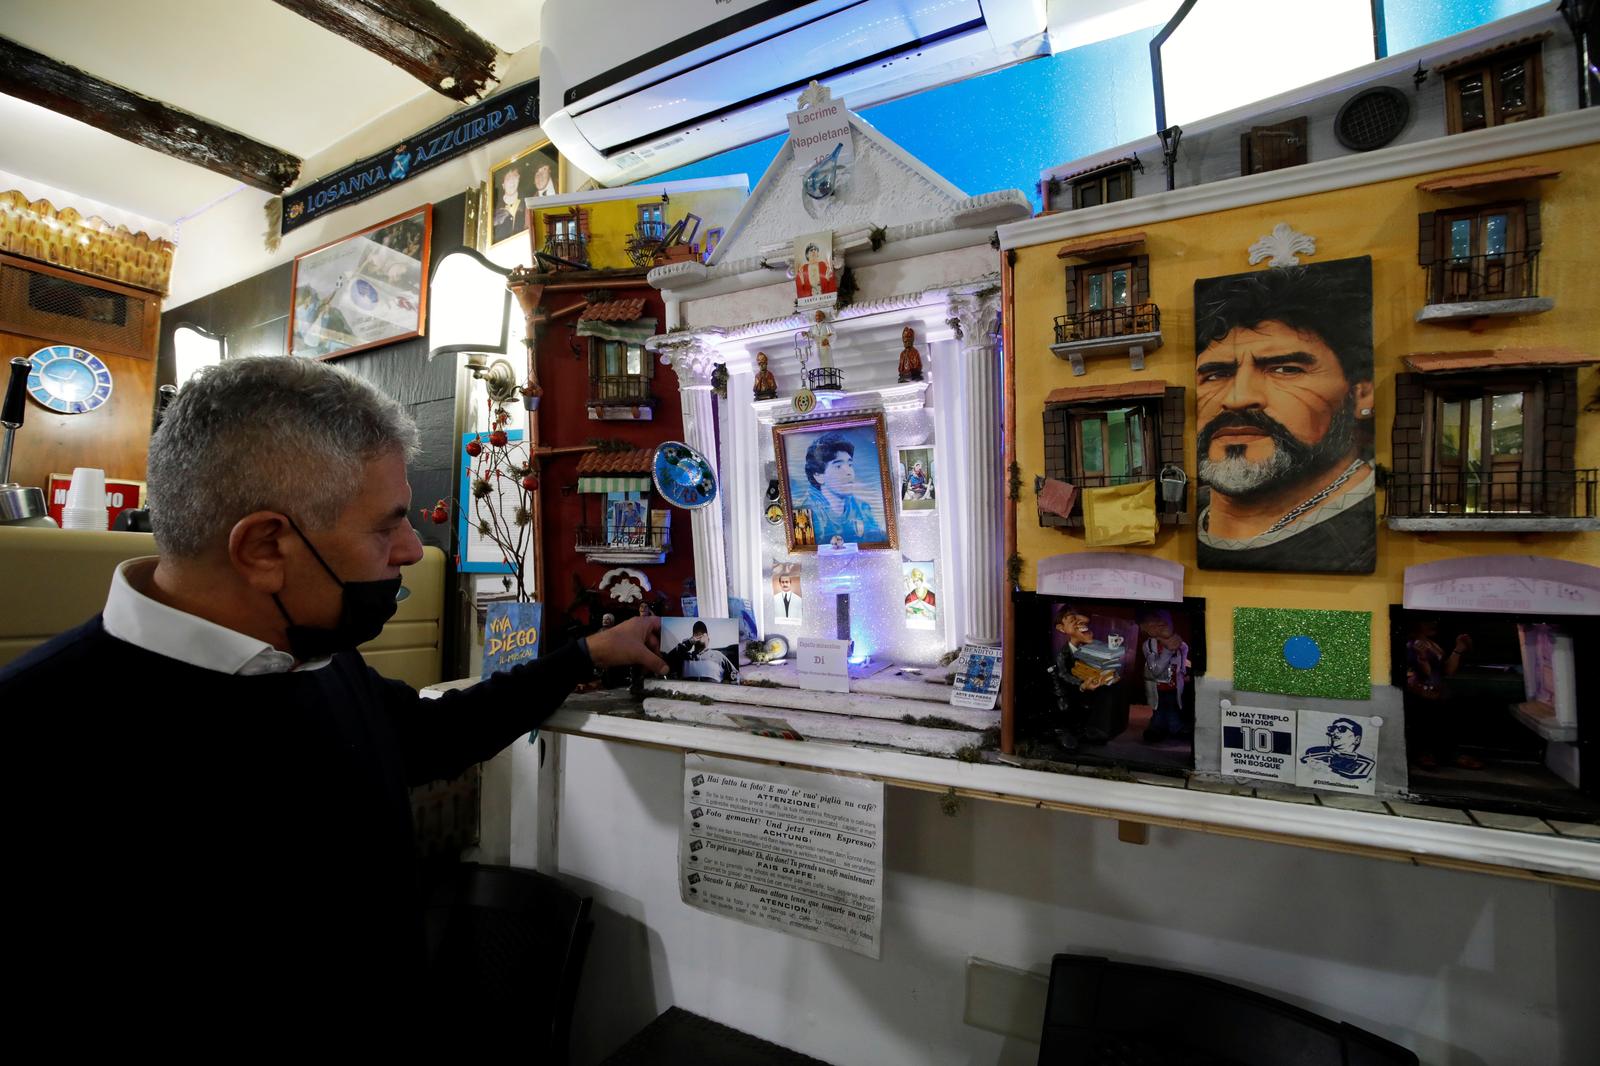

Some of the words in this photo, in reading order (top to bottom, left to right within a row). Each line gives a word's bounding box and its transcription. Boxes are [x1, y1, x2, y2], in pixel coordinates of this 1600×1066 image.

[796, 105, 838, 125] Lacrime
[413, 104, 519, 166] AZZURRA
[792, 125, 850, 149] Napoletane
[1257, 713, 1289, 722] TEMPLO
[1241, 725, 1274, 754] 10
[1248, 760, 1281, 770] BOSQUE
[1262, 756, 1285, 764] LOBO
[707, 775, 720, 784] Hai
[721, 777, 738, 787] fatto
[740, 780, 747, 788] la
[749, 782, 766, 792] foto?
[768, 785, 775, 793] E
[706, 808, 722, 818] Foto
[725, 813, 761, 825] gemacht?
[766, 819, 782, 830] Und
[785, 824, 806, 834] jetzt
[809, 829, 831, 839] einen
[836, 833, 876, 849] Espresso?
[757, 861, 779, 871] FAIS
[782, 867, 816, 880] GAFFE:
[790, 858, 798, 867] Tu
[818, 866, 826, 874] un
[725, 878, 732, 887] la
